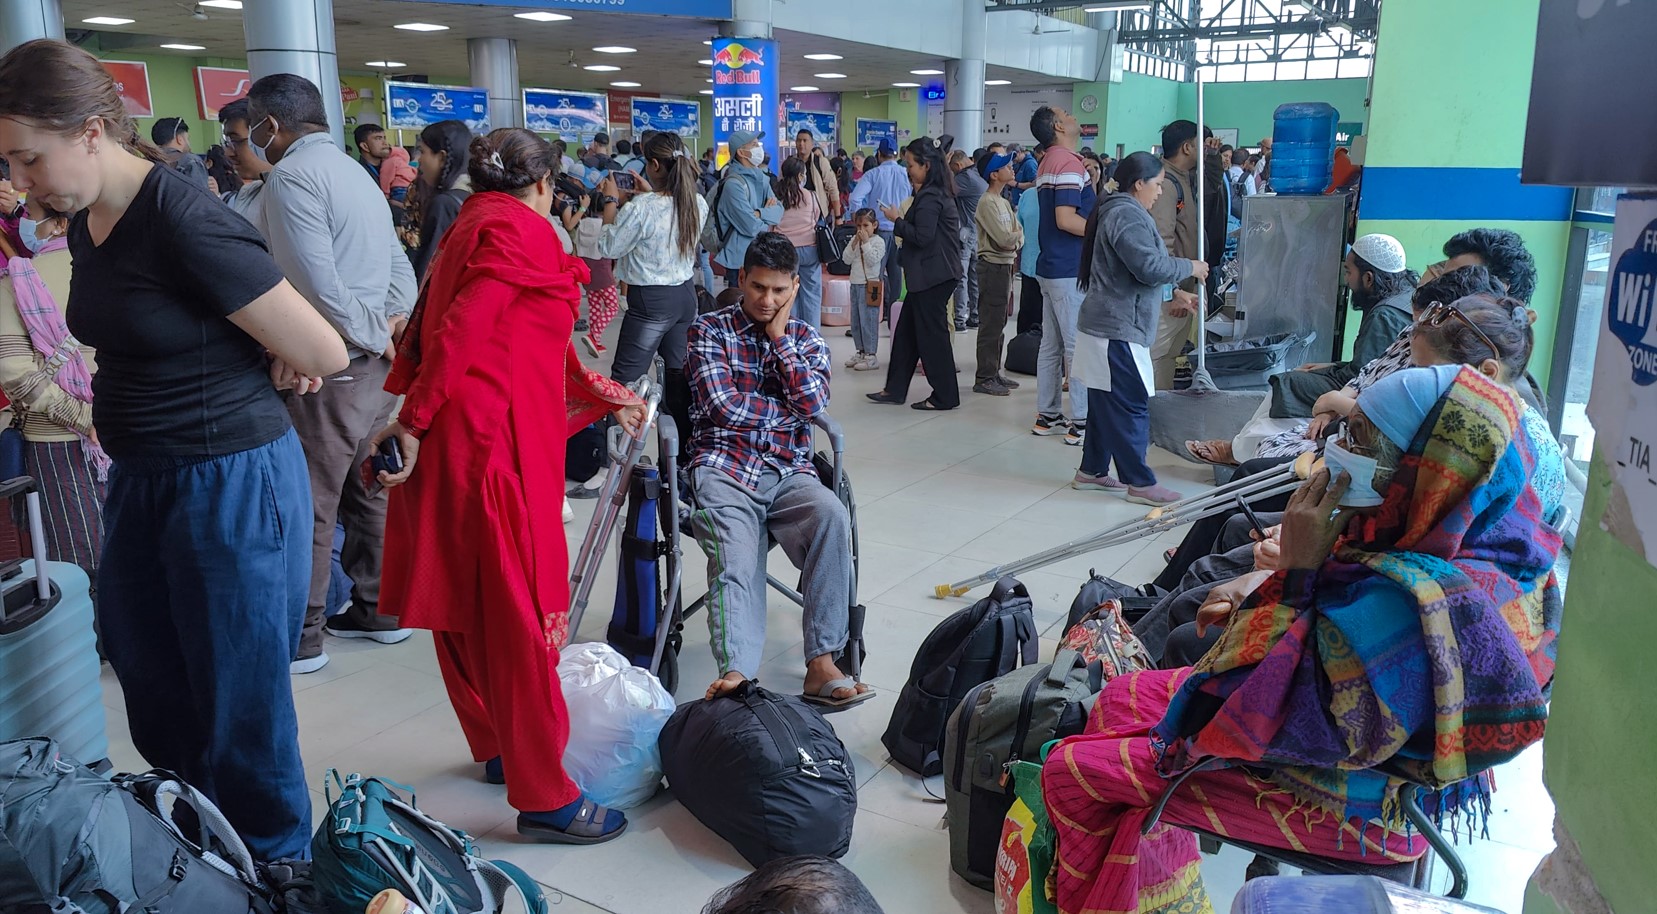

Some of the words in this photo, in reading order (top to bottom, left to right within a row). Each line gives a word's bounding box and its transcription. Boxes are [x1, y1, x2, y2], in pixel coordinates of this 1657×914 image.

[715, 69, 735, 84] Red
[735, 69, 761, 84] Bull
[715, 93, 763, 117] असली
[1335, 132, 1350, 142] Air
[1628, 345, 1657, 376] ZONE
